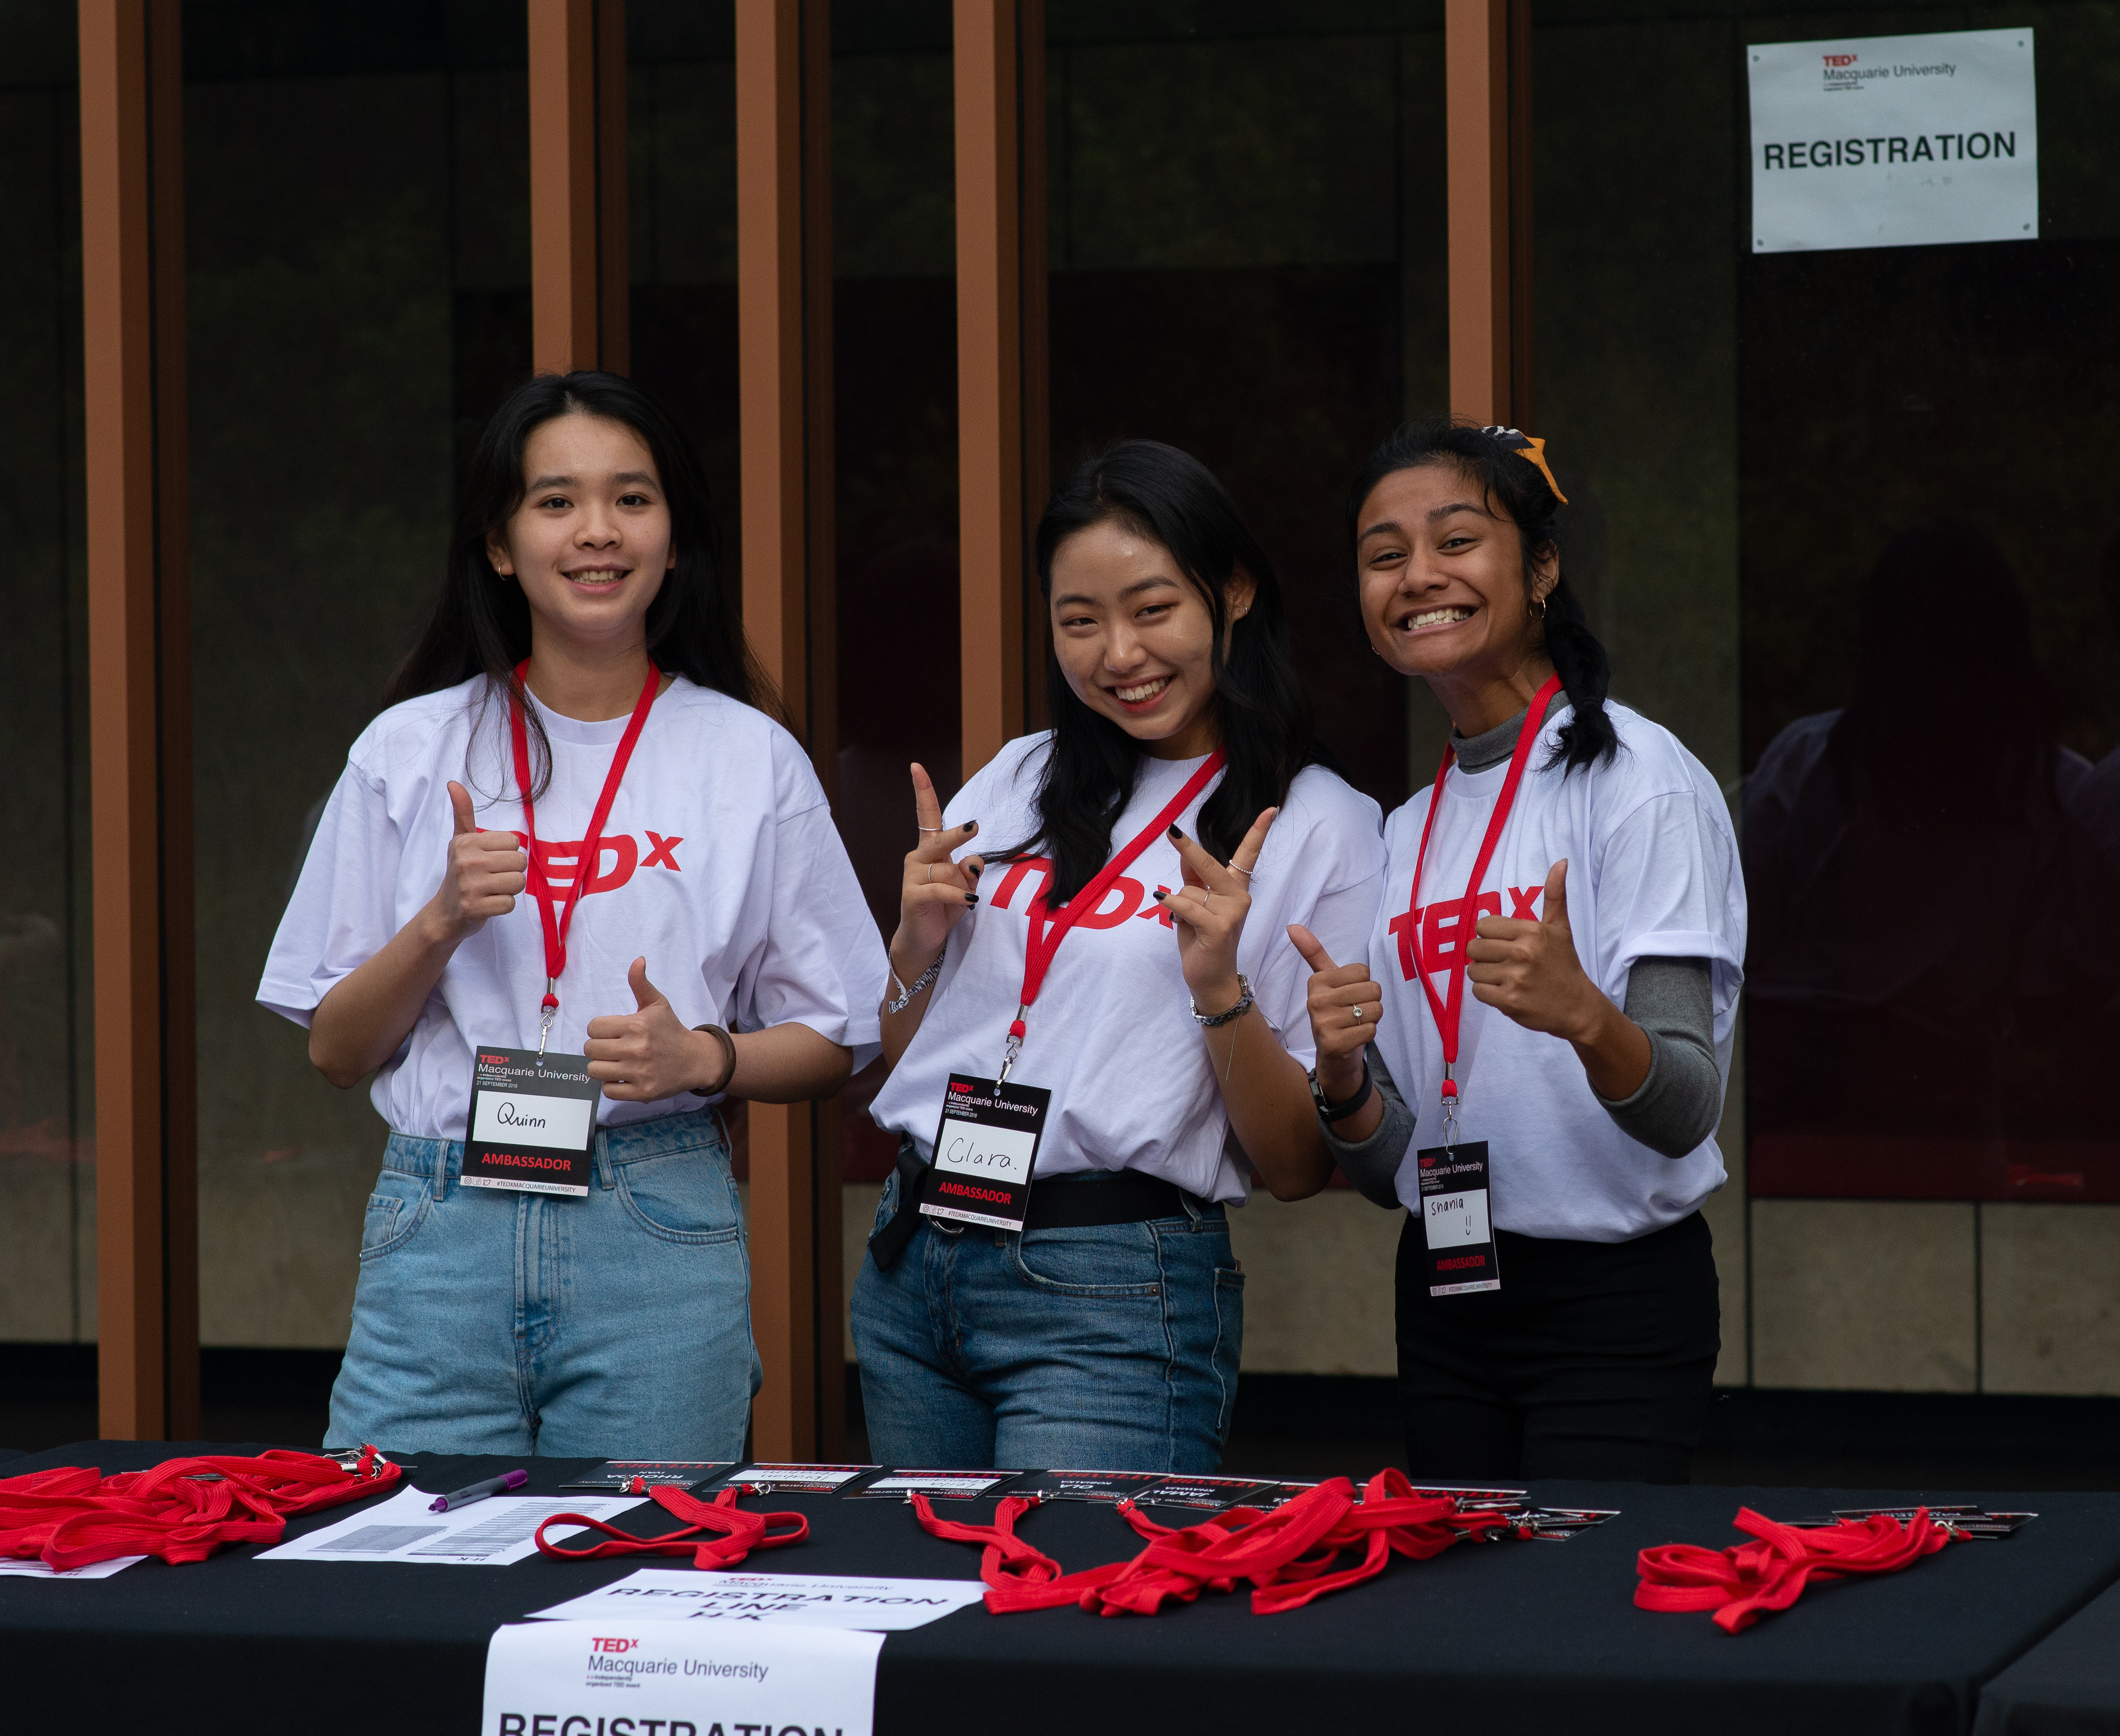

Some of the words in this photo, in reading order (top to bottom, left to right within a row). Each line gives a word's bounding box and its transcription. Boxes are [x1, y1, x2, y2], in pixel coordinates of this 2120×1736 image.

[1823, 67, 1889, 82] Macquarie
[1893, 63, 1956, 78] University
[1764, 131, 2016, 170] REGISTRATION
[476, 827, 684, 902] EDx
[990, 852, 1174, 930] TDx
[478, 1063, 535, 1077] Macquarie
[538, 1069, 591, 1084] University
[948, 1091, 992, 1107] Macquarie
[995, 1099, 1038, 1117] University
[497, 1102, 546, 1129] Quinn
[481, 1153, 571, 1171] AMBASSADOR
[1420, 1166, 1451, 1177] Macquarie
[1452, 1161, 1483, 1173] University
[497, 1181, 576, 1193] #TEDXMACQUARIEUNIVERSITY
[939, 1181, 1011, 1204] AMBASSADOR
[1431, 1198, 1464, 1216] Shania
[948, 1211, 1012, 1227] #TEDXMACQUARIEUNIVERSITY
[1437, 1255, 1485, 1271] AMBASSADOR
[606, 1588, 950, 1605] REGISTRATION
[701, 1602, 808, 1611] LINE
[688, 1611, 772, 1621] H-K
[592, 1637, 639, 1653] TEDx
[588, 1656, 677, 1676] Macquarie
[684, 1659, 769, 1683] University
[500, 1713, 843, 1736] REGIST
